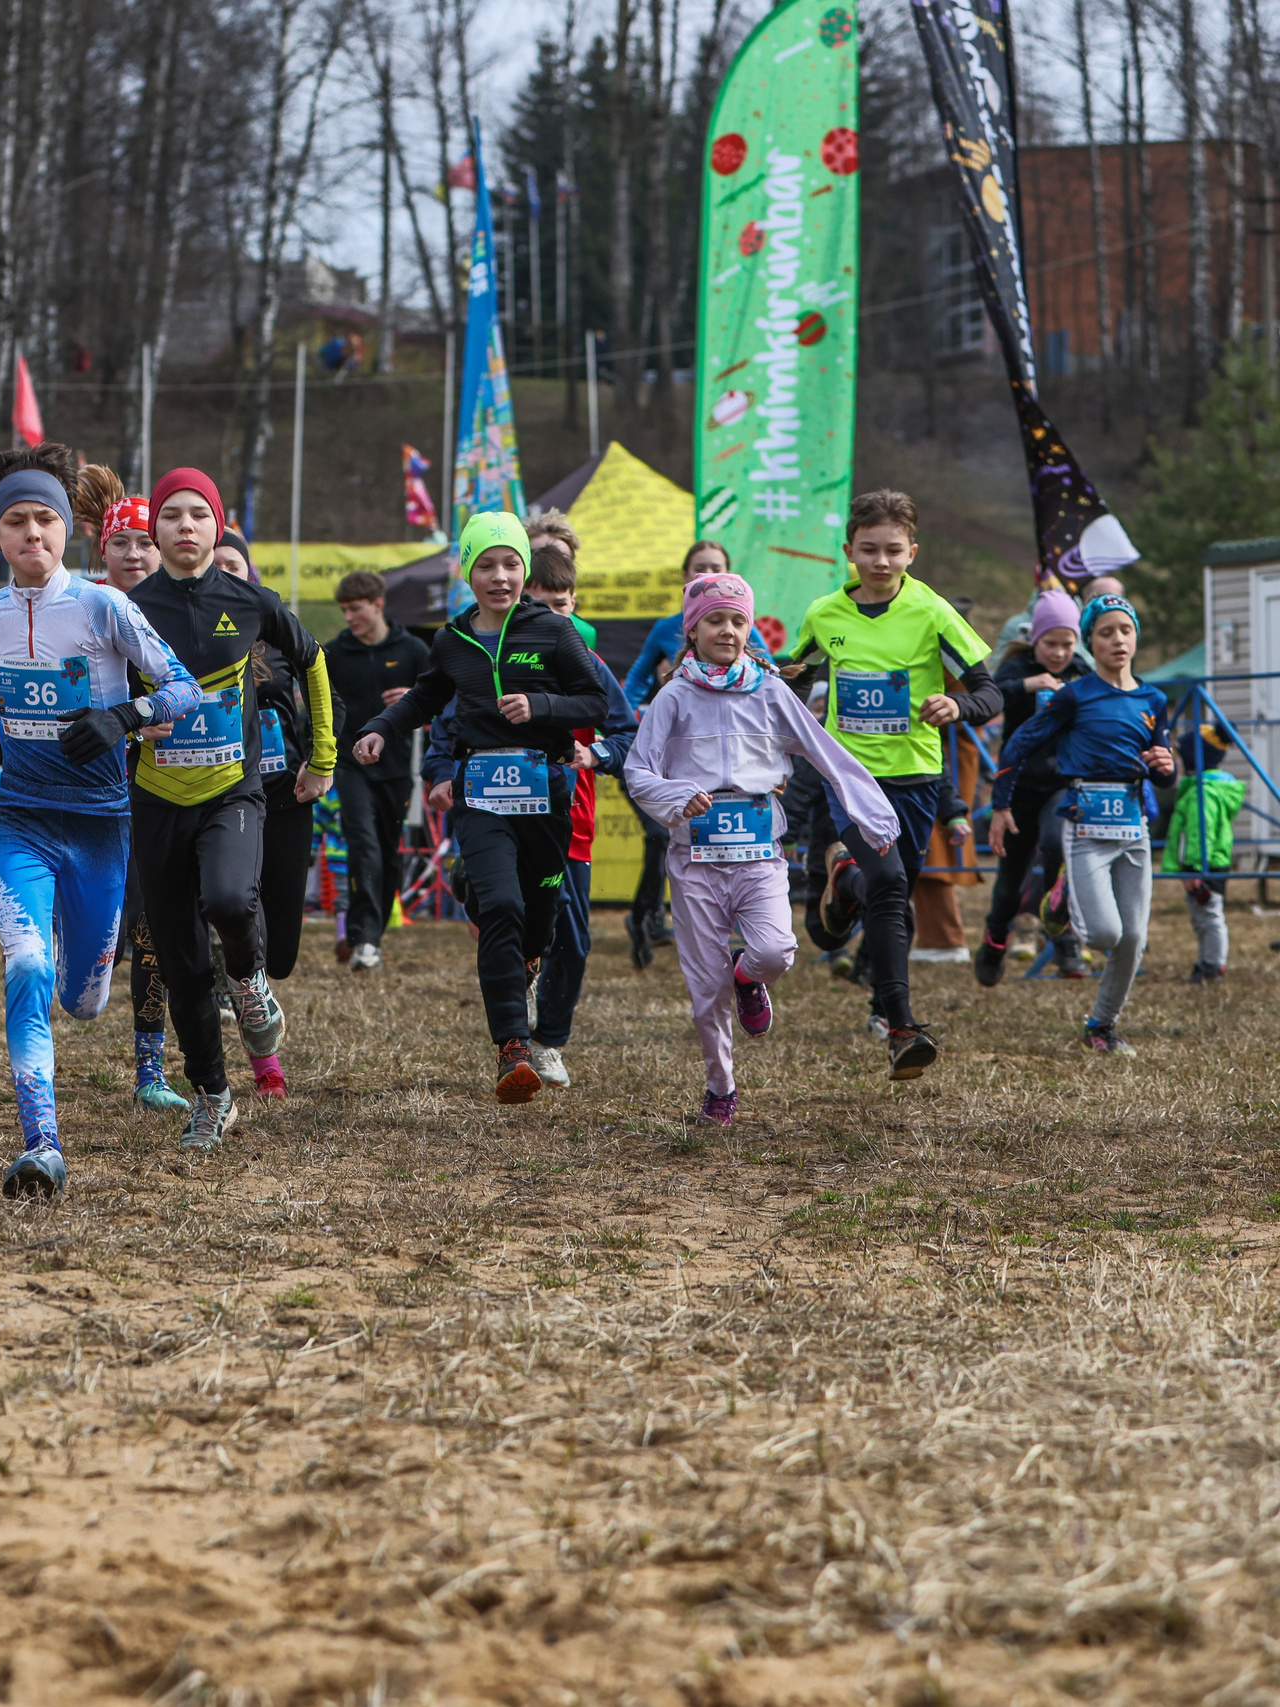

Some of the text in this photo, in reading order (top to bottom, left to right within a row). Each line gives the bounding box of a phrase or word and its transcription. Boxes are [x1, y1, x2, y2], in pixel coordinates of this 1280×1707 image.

[505, 652, 540, 664] FILA
[24, 681, 58, 706] 36
[856, 689, 884, 708] 30
[4, 706, 46, 716] Барышников
[191, 714, 208, 735] 4
[173, 734, 227, 745] Богданова Алёна
[491, 765, 521, 786] 48
[1101, 798, 1124, 816] 18
[717, 812, 748, 833] 51
